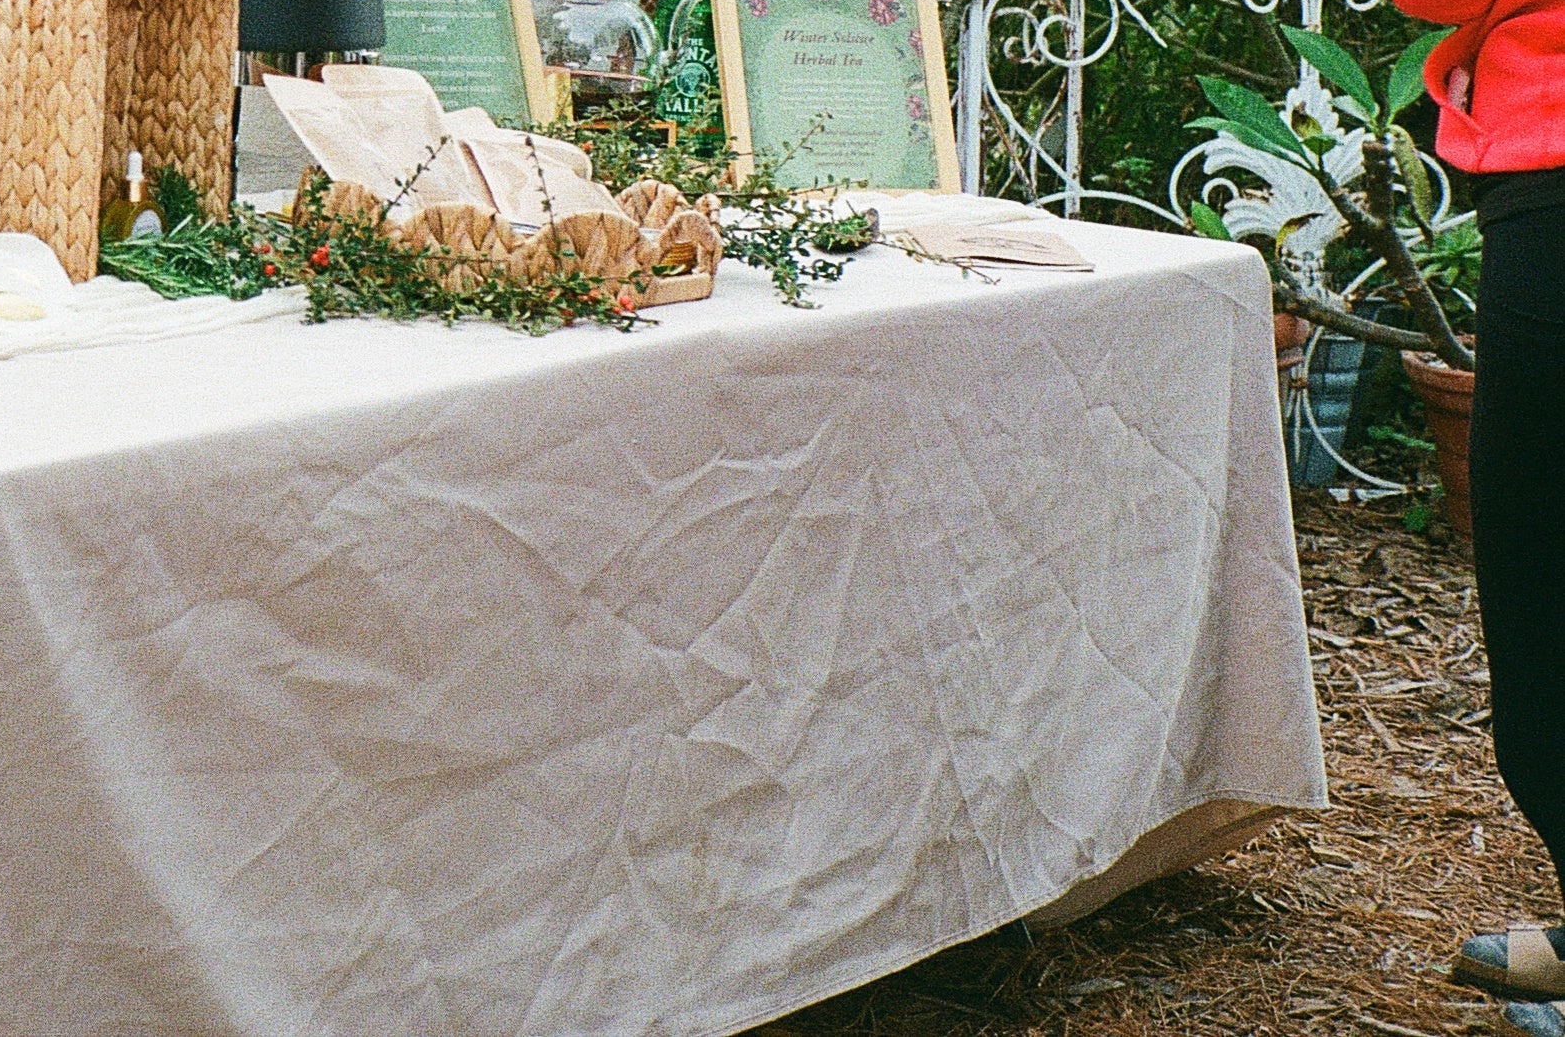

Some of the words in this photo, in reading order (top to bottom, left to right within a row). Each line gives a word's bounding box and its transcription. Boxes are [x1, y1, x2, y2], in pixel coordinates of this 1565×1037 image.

[783, 30, 827, 44] Winter
[793, 51, 837, 66] Herbal
[842, 52, 863, 66] Tea
